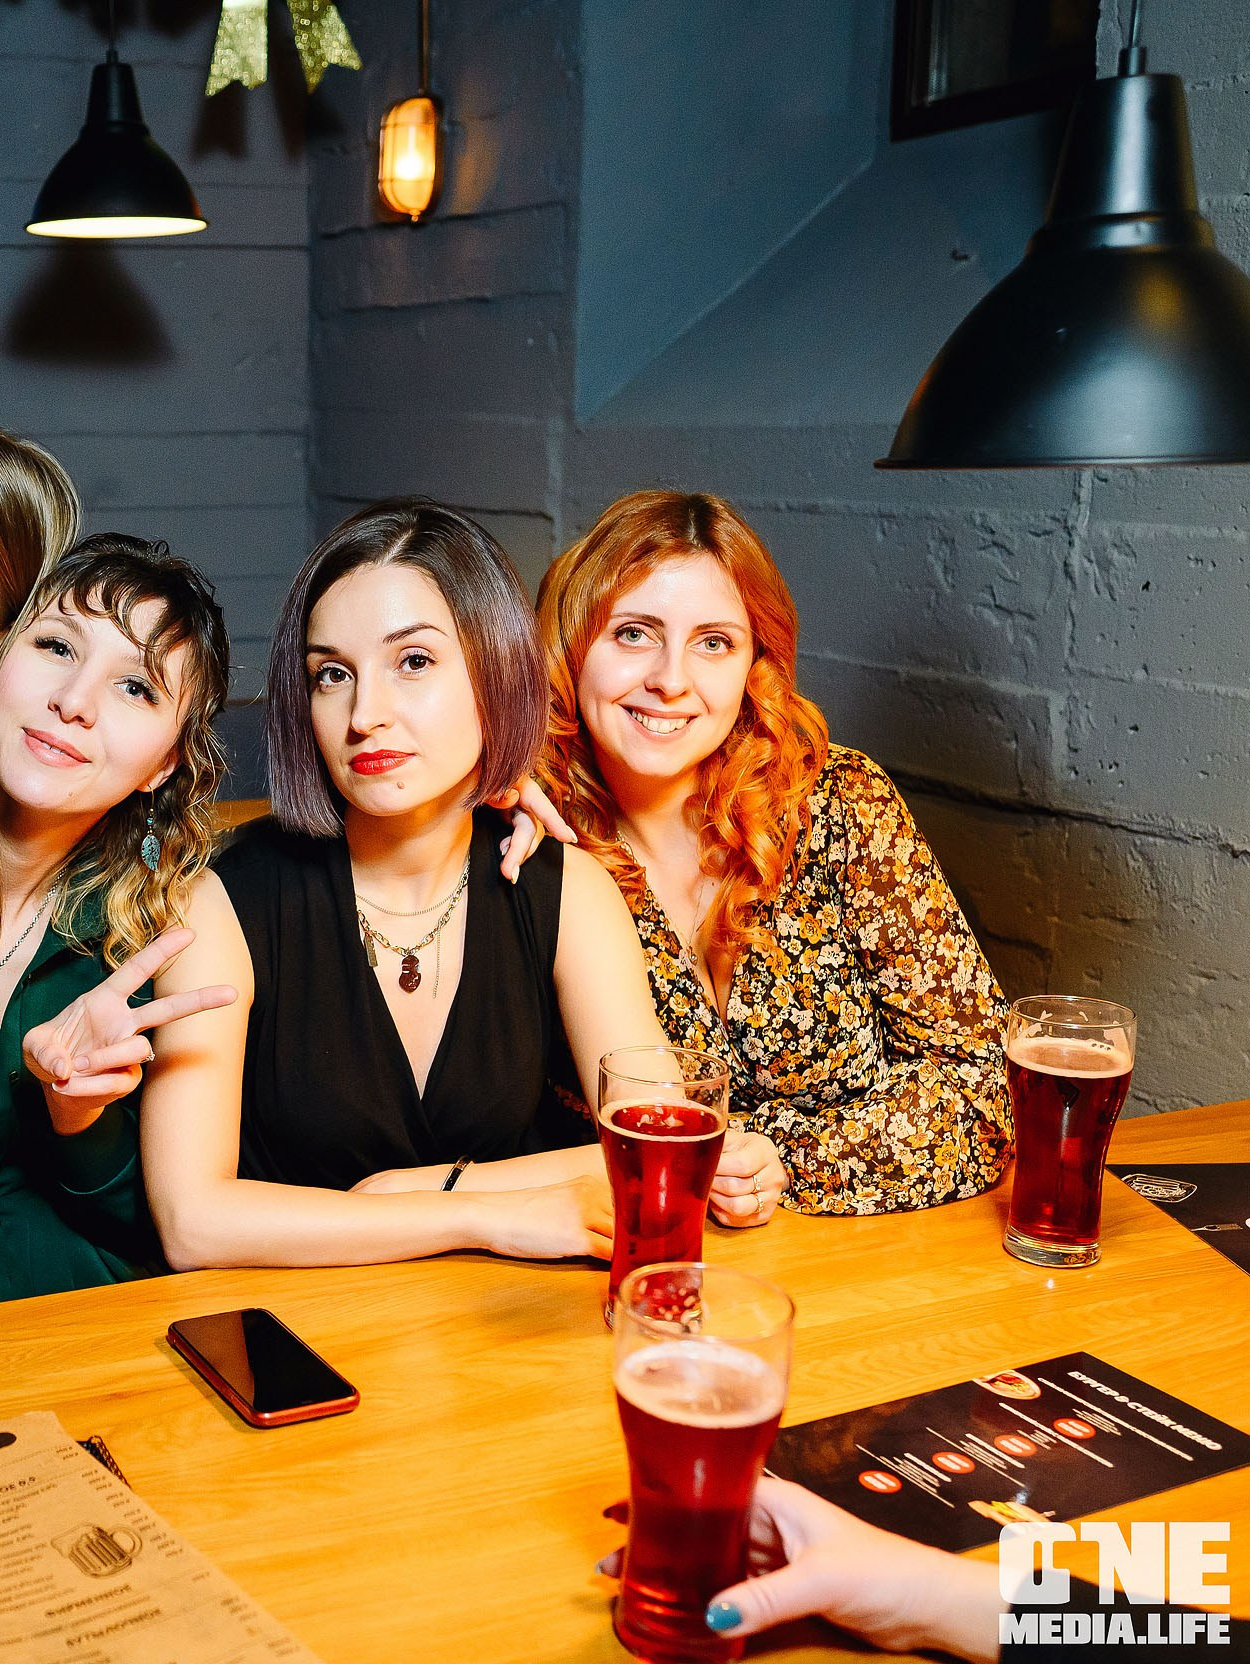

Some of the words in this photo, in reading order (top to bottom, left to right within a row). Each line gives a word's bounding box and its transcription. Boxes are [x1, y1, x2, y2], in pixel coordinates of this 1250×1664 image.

[1066, 1371, 1120, 1397] БУРГЕР
[1127, 1402, 1177, 1427] СТЕЙК
[1170, 1424, 1223, 1451] МЕНЮ
